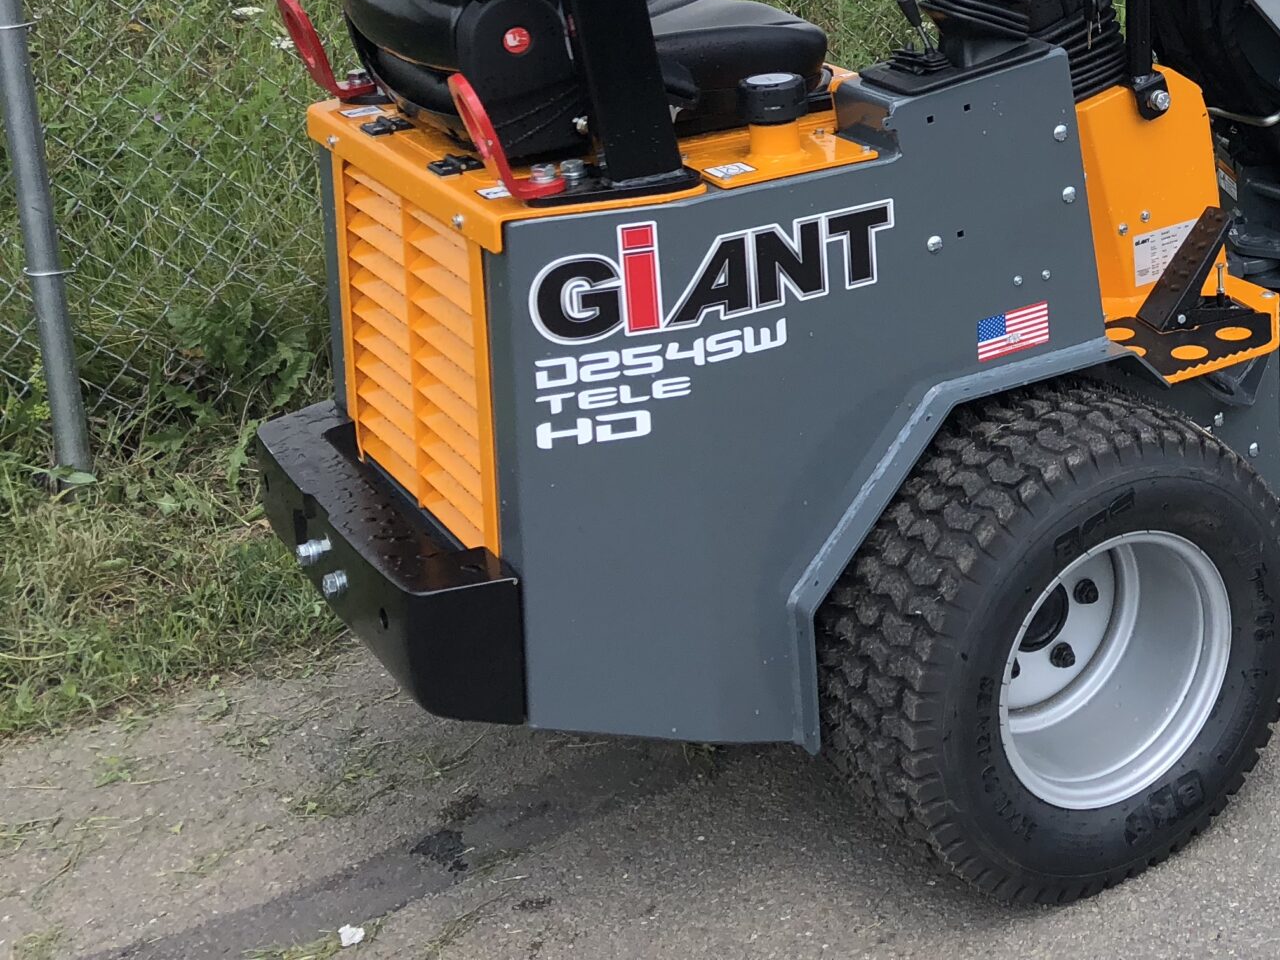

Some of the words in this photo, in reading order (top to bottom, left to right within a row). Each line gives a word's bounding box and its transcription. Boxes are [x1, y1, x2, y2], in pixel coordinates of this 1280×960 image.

[535, 317, 787, 389] D254SW
[535, 376, 691, 415] TELE
[535, 410, 652, 450] HD
